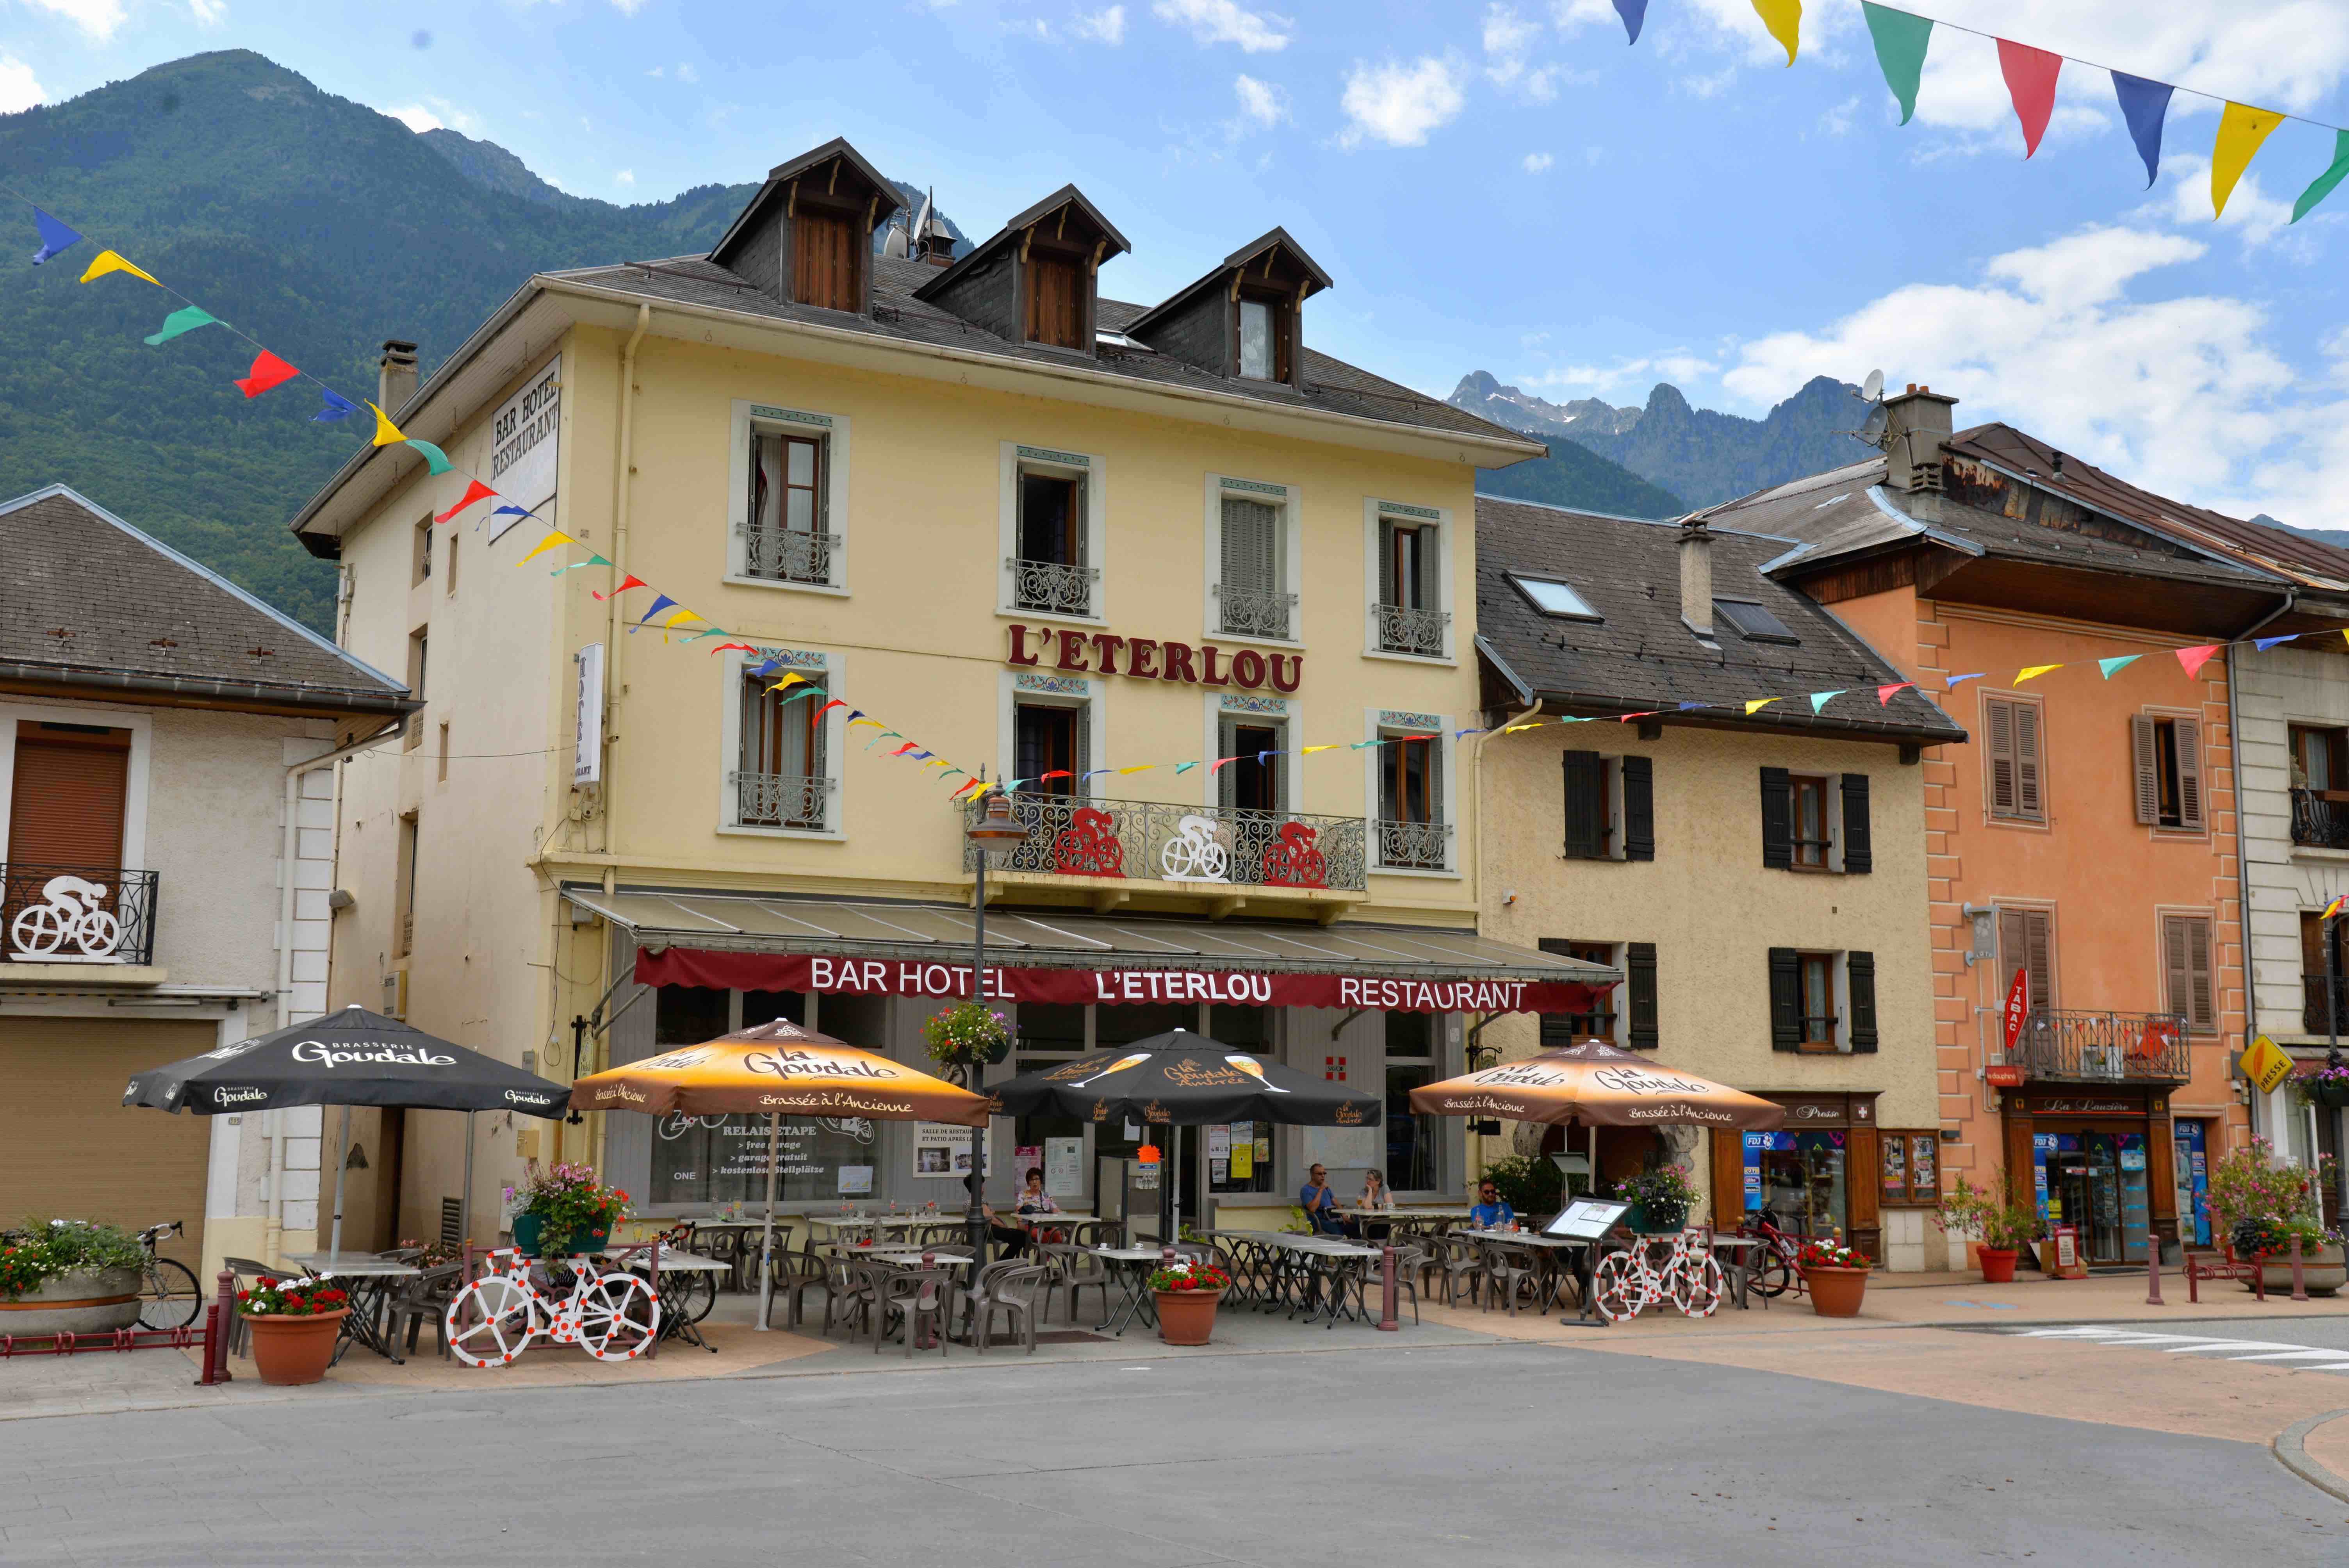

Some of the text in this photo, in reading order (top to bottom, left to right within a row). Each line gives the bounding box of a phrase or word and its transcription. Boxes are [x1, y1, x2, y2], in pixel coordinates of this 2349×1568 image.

[496, 371, 556, 447] BAR HOTEL
[493, 401, 558, 481] RESTAURANT
[1007, 624, 1303, 693] L'ETERLOU
[576, 656, 586, 763] HOTEL
[812, 958, 1527, 1009] BAR HOTEL L'ETERLOU RESTAURANT
[2009, 986, 2022, 1031] TABAC
[292, 1041, 457, 1068] Goudale
[332, 1042, 414, 1050] BRASSERIE
[743, 1052, 900, 1080] Goudale
[1164, 1066, 1243, 1082] Goudale
[2261, 1059, 2287, 1090] PRESSE
[1595, 1070, 1709, 1095] Goudale
[214, 1087, 268, 1107] Goudale
[505, 1090, 551, 1105] Goudale
[758, 1093, 914, 1112] Brassée à l'Ancienne
[1444, 1096, 1525, 1112] Brassée à l'Ancienne
[2044, 1099, 2069, 1110] La
[1628, 1104, 1734, 1121] Brassée à l'Ancienne
[1797, 1105, 1839, 1119] Presse
[723, 1126, 816, 1136] RELAIS ETAPE
[746, 1141, 766, 1149] free
[775, 1153, 808, 1162] gratuit
[775, 1165, 824, 1175] Stellplätze
